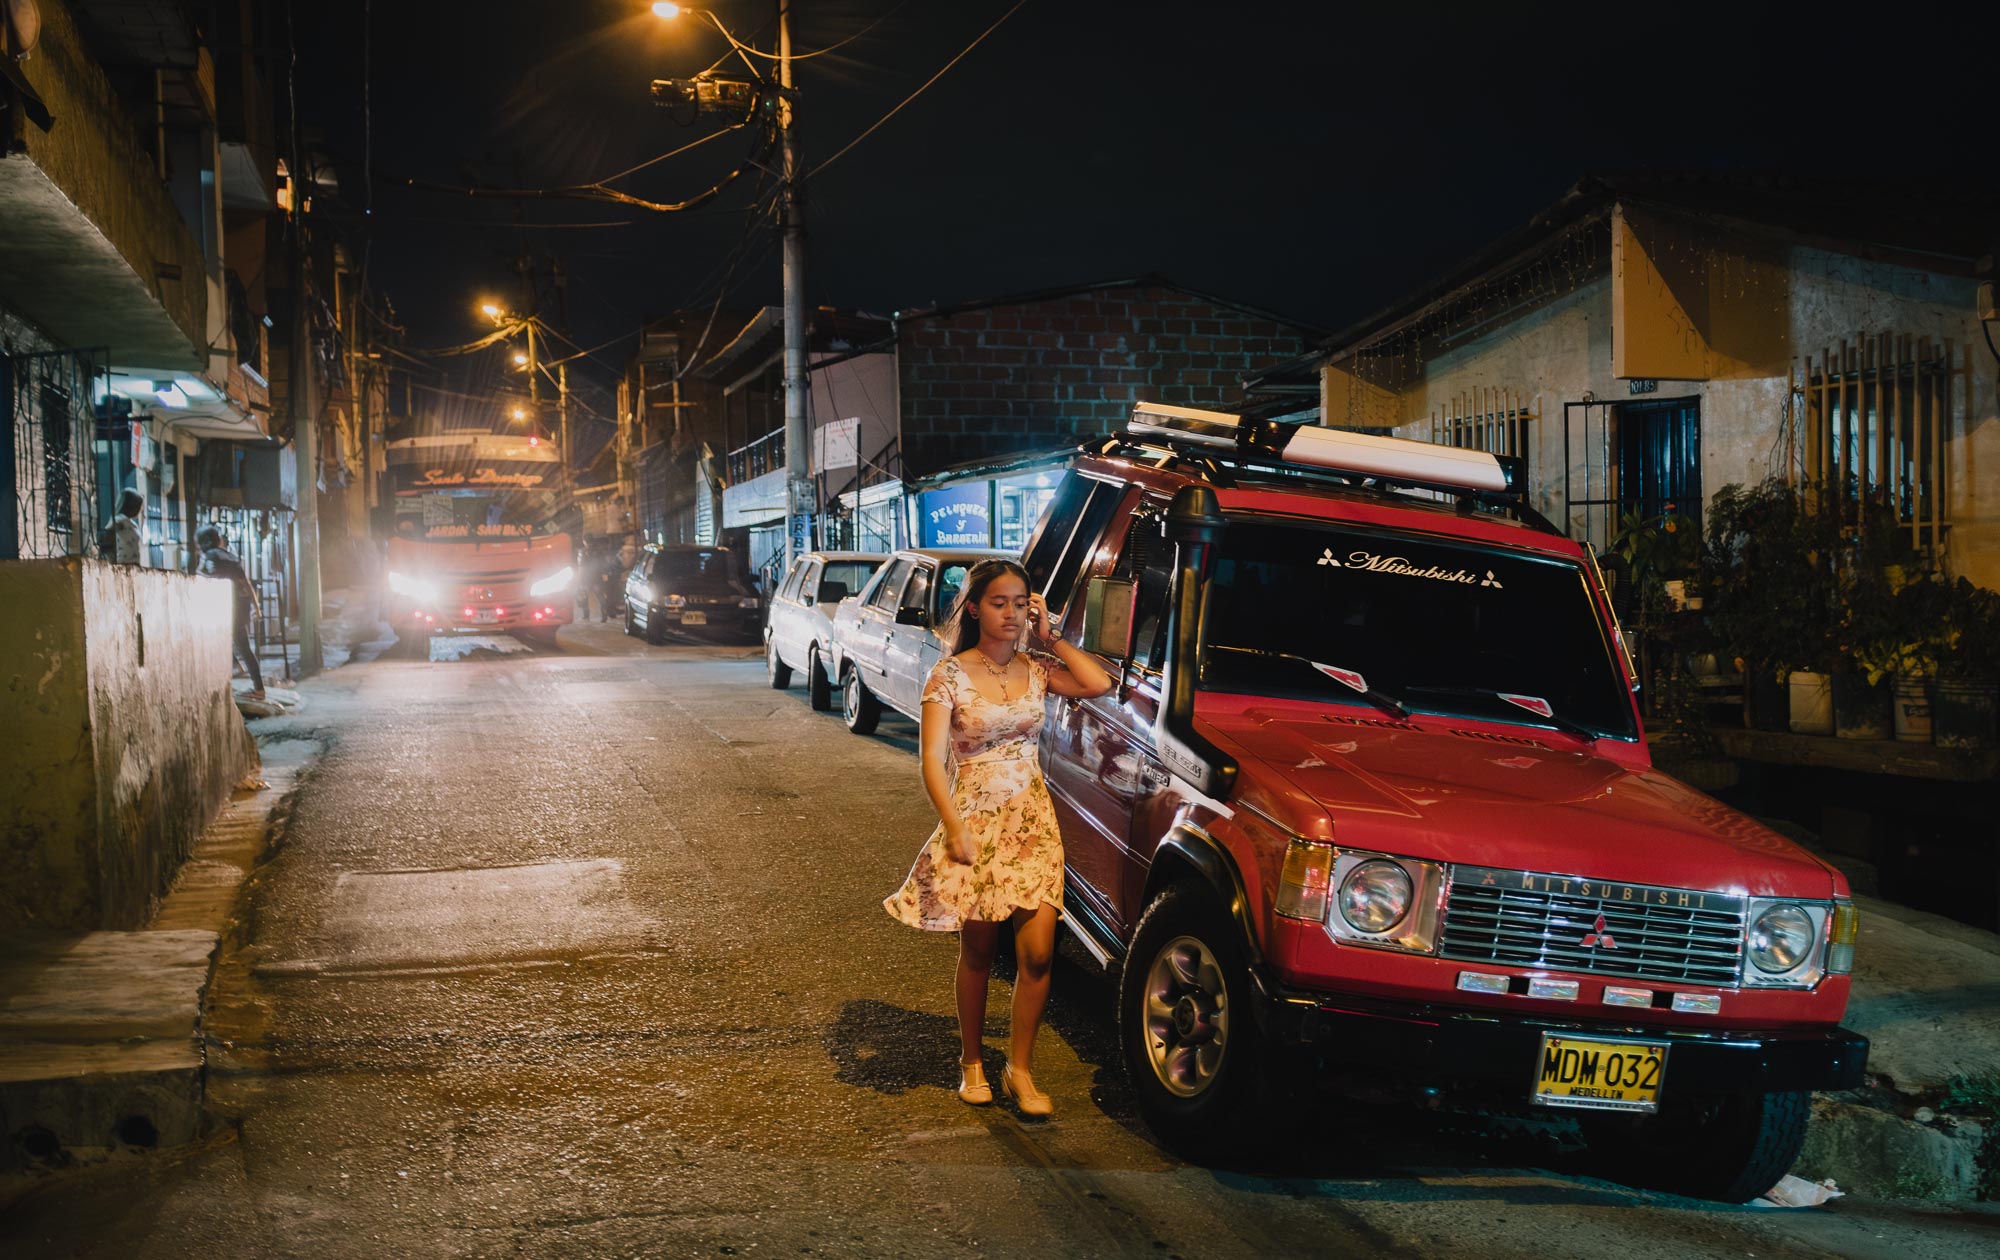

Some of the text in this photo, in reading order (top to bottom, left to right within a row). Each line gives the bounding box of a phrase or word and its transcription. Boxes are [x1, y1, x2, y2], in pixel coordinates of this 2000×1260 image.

[468, 468, 544, 487] Domingo
[477, 524, 502, 536] SAN
[1344, 551, 1477, 585] Mitsubishi
[1521, 875, 1705, 909] MITSUBISHI
[1569, 1086, 1625, 1100] MEDELLIN
